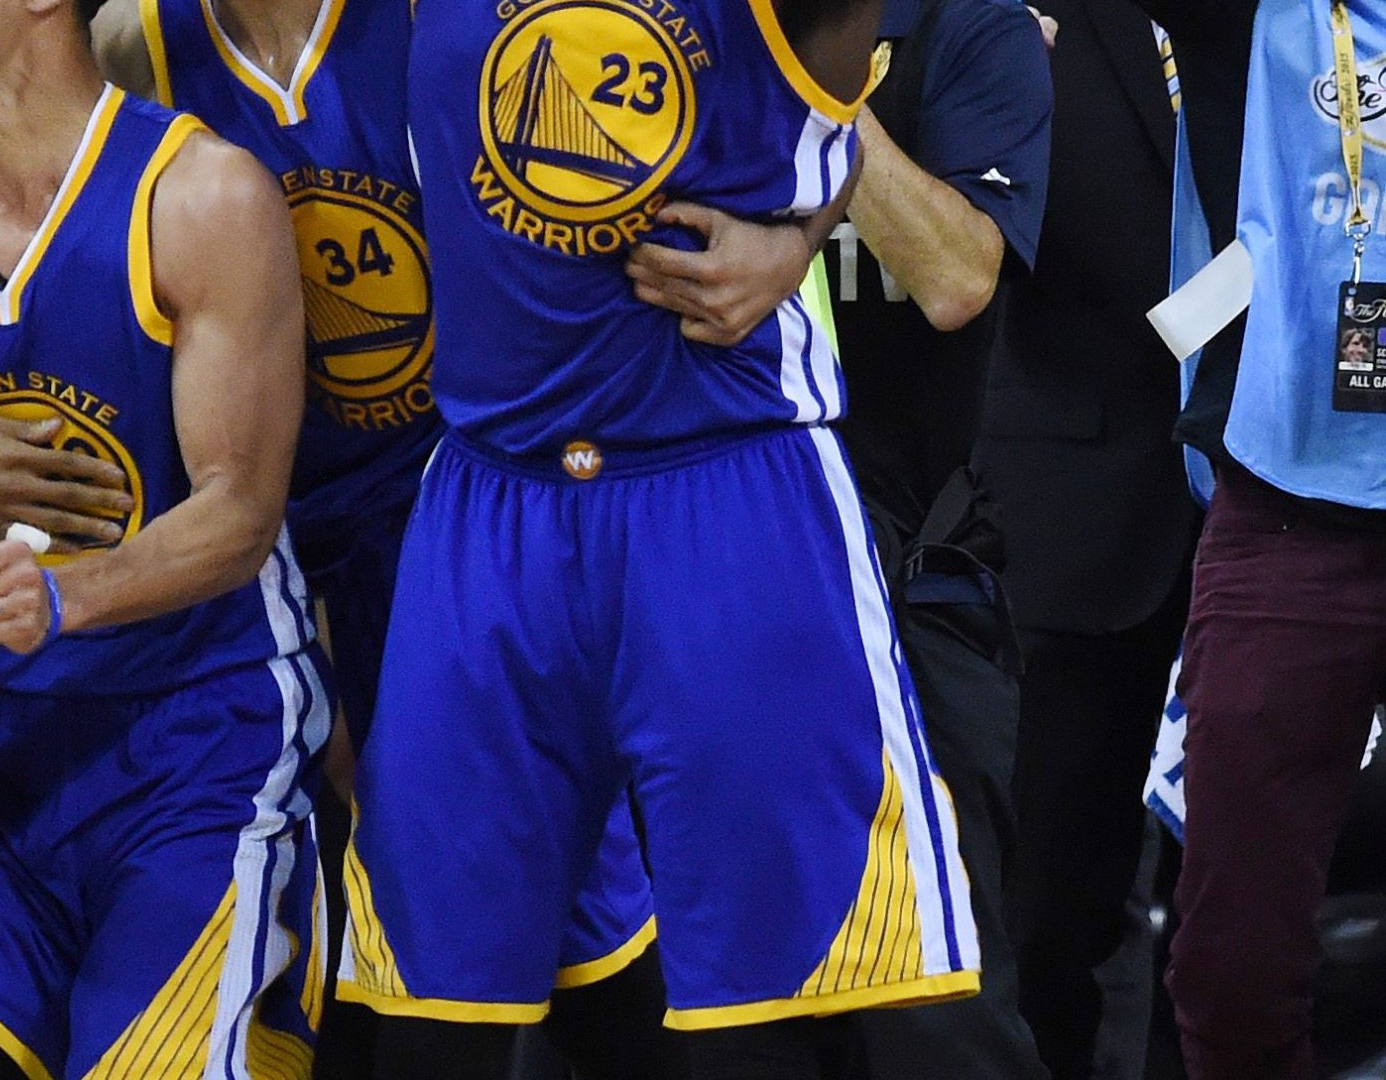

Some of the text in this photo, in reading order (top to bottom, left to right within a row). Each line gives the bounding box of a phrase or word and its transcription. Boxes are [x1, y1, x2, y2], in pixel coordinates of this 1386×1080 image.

[591, 53, 667, 116] 23
[320, 168, 415, 215] STATE
[315, 227, 394, 287] 34
[28, 371, 119, 426] STATE
[1349, 375, 1371, 388] ALL
[566, 450, 595, 471] W
